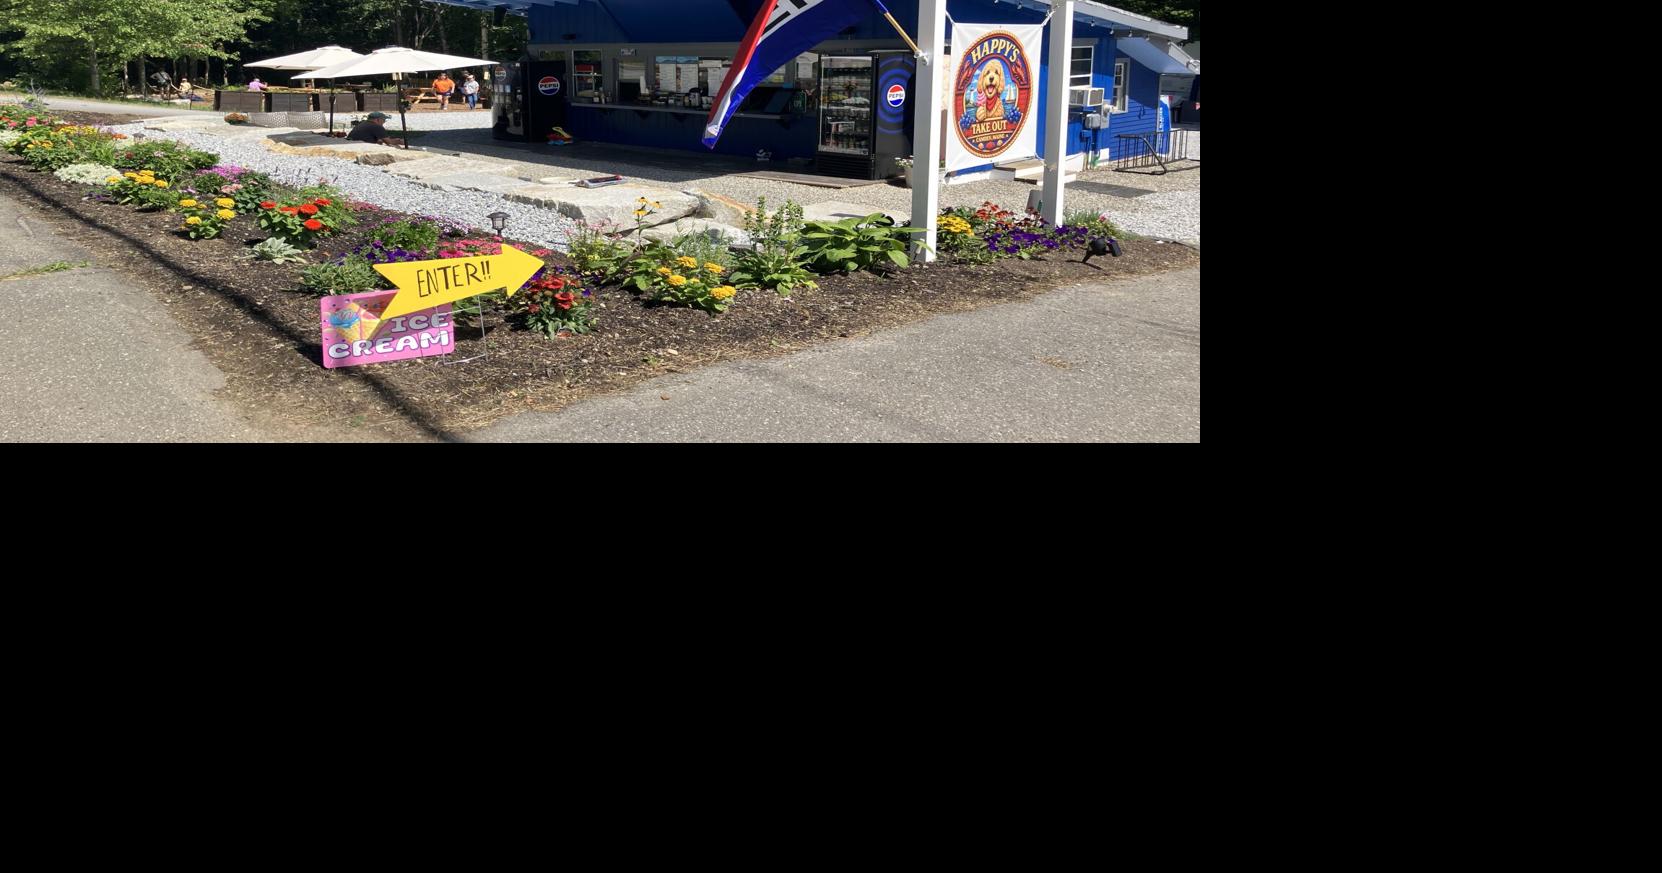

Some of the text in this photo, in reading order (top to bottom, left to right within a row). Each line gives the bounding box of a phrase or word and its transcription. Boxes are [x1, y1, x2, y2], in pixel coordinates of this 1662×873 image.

[971, 39, 1019, 64] HAPPY'S
[972, 120, 1007, 134] TAKE OUT
[416, 260, 492, 298] ENTER!!
[390, 313, 450, 334] ICE
[327, 330, 450, 359] CREAM
